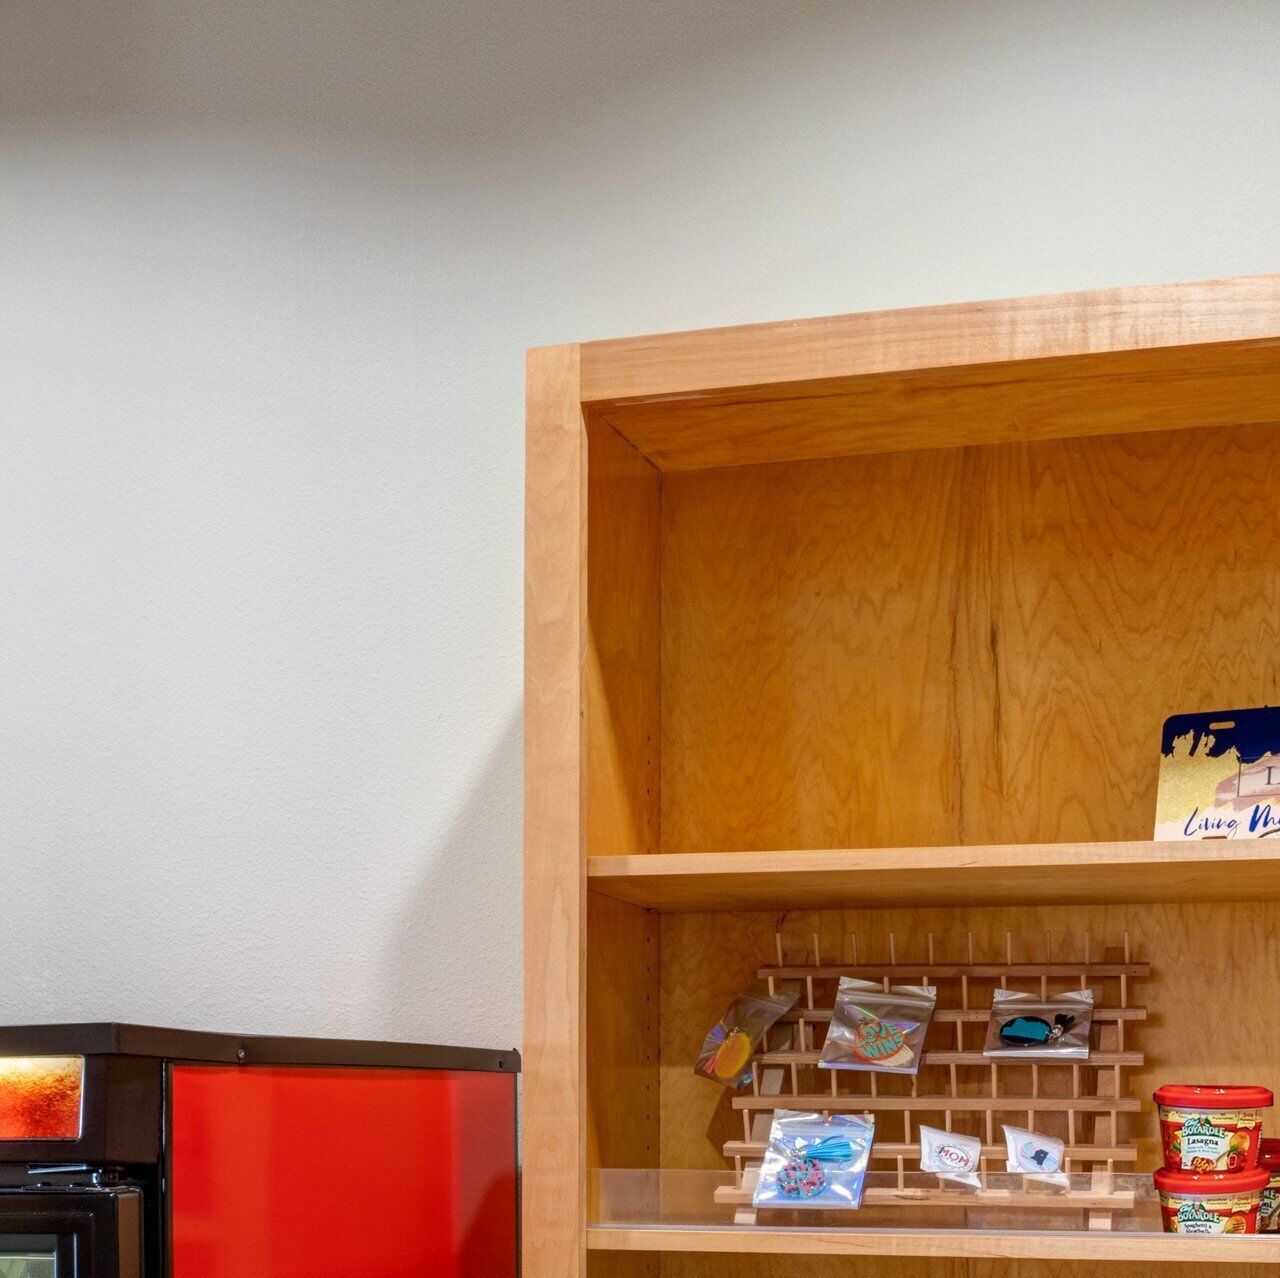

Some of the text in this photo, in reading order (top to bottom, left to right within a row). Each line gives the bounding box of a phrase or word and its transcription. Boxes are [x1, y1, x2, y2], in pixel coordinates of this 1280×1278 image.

[1184, 806, 1241, 839] Living
[861, 1036, 904, 1058] WINS
[1187, 1138, 1219, 1147] Lasagna
[938, 1146, 970, 1166] MOM
